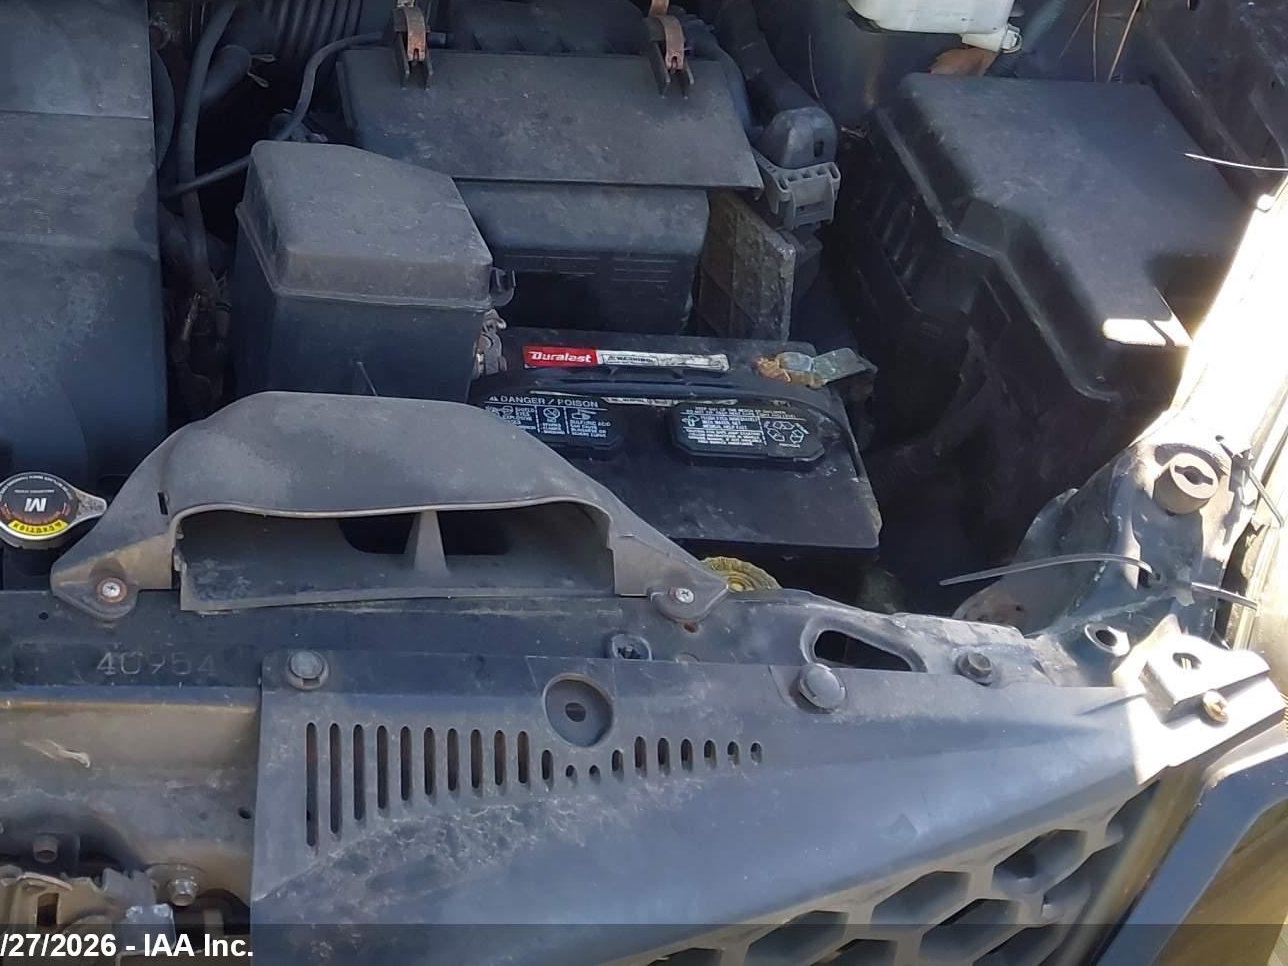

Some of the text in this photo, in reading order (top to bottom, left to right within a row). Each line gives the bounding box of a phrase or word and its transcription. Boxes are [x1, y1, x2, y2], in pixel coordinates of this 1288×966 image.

[528, 351, 592, 363] Duralast
[500, 395, 545, 405] DANGER
[557, 398, 599, 408] POISON
[13, 520, 55, 533] CAUTION
